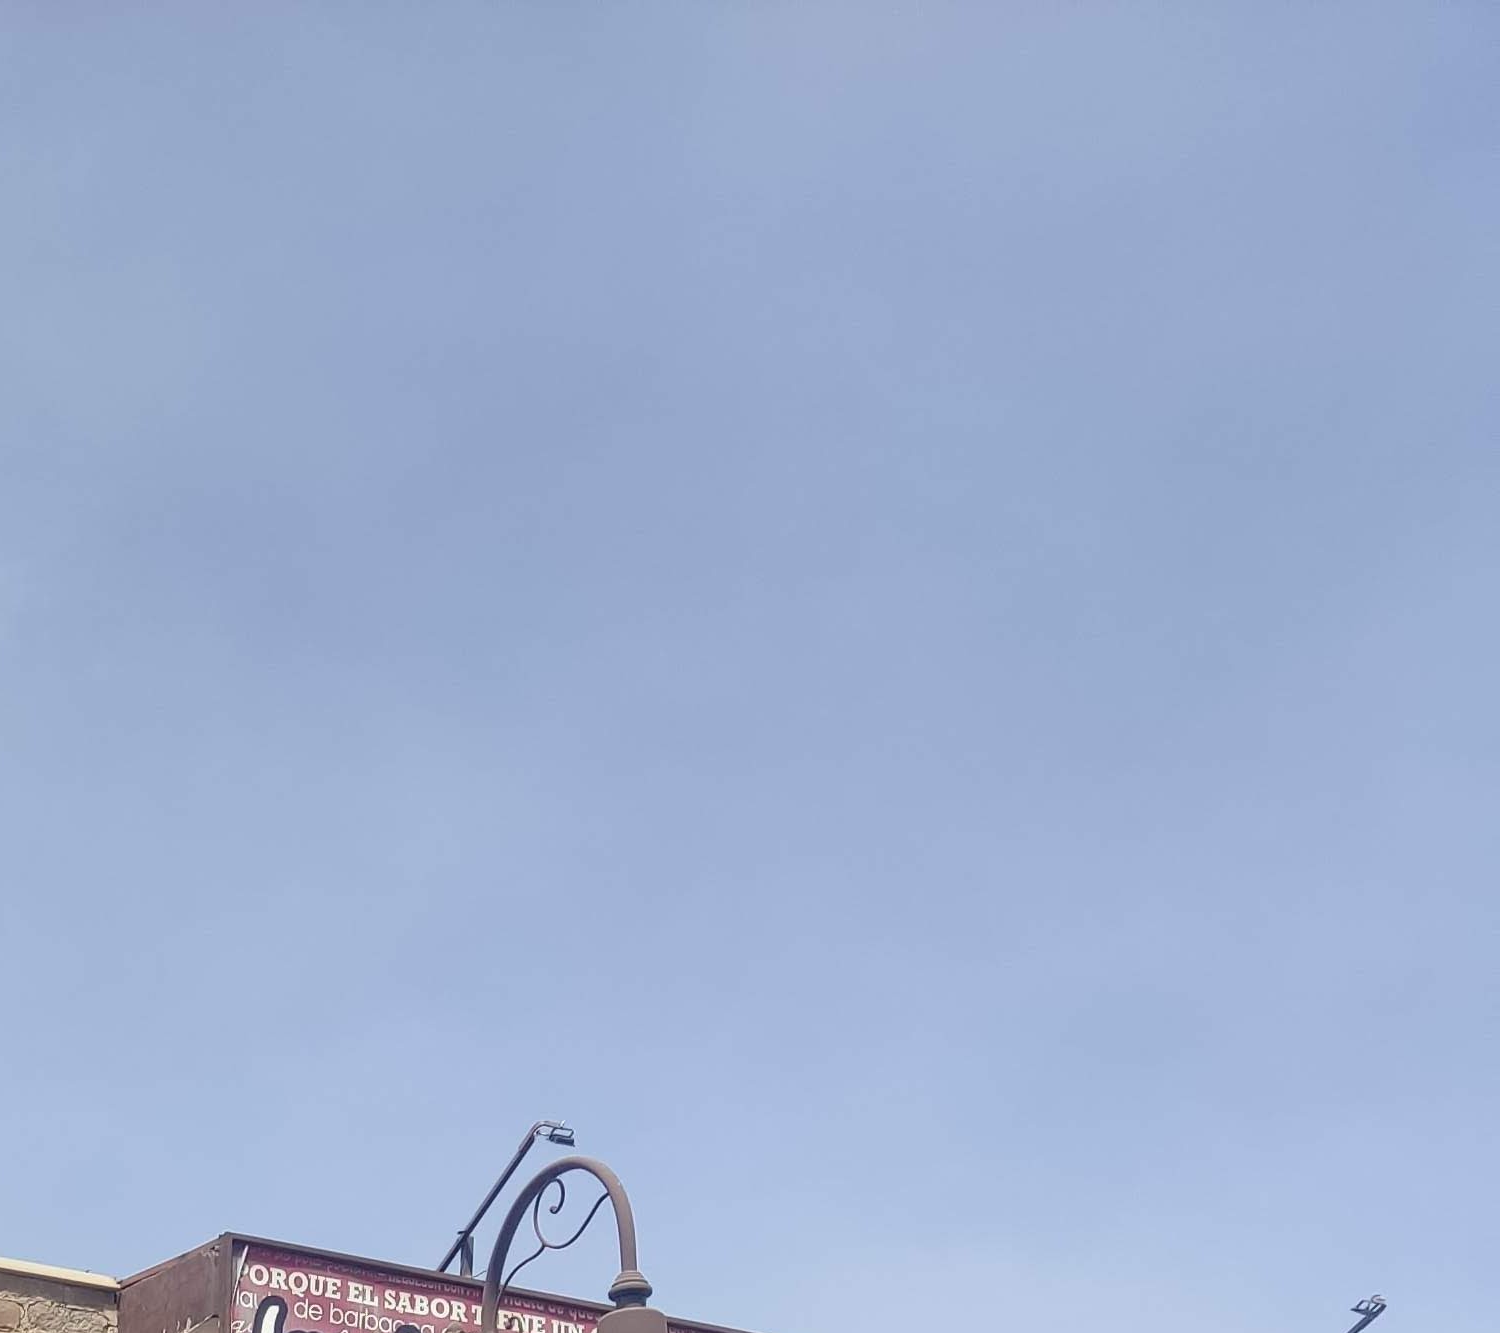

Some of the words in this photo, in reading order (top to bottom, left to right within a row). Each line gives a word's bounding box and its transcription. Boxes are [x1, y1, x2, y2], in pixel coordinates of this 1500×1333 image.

[241, 1263, 342, 1299] ORQUE
[347, 1281, 378, 1307] EL
[384, 1289, 468, 1323] SABOR
[293, 1299, 323, 1321] de
